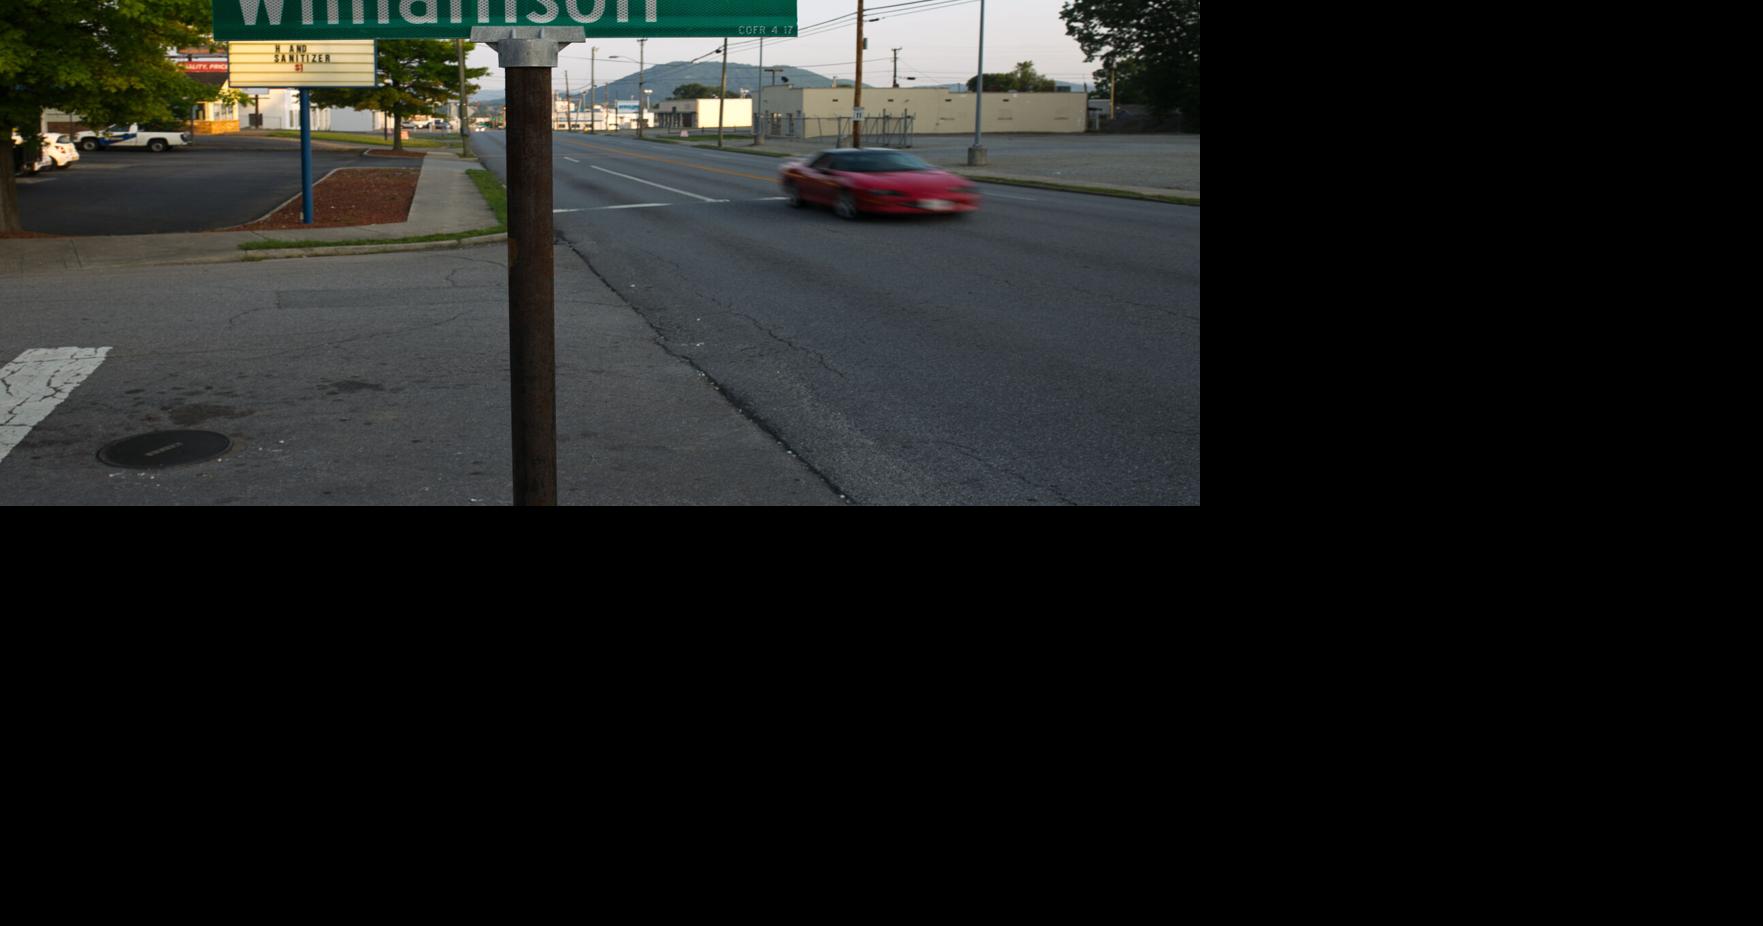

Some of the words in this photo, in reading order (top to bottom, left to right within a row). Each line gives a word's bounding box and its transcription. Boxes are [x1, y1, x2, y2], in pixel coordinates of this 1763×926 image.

[771, 25, 778, 35] 4
[784, 25, 794, 35] 17
[274, 54, 330, 63] SANITIZER
[295, 63, 303, 72] $1
